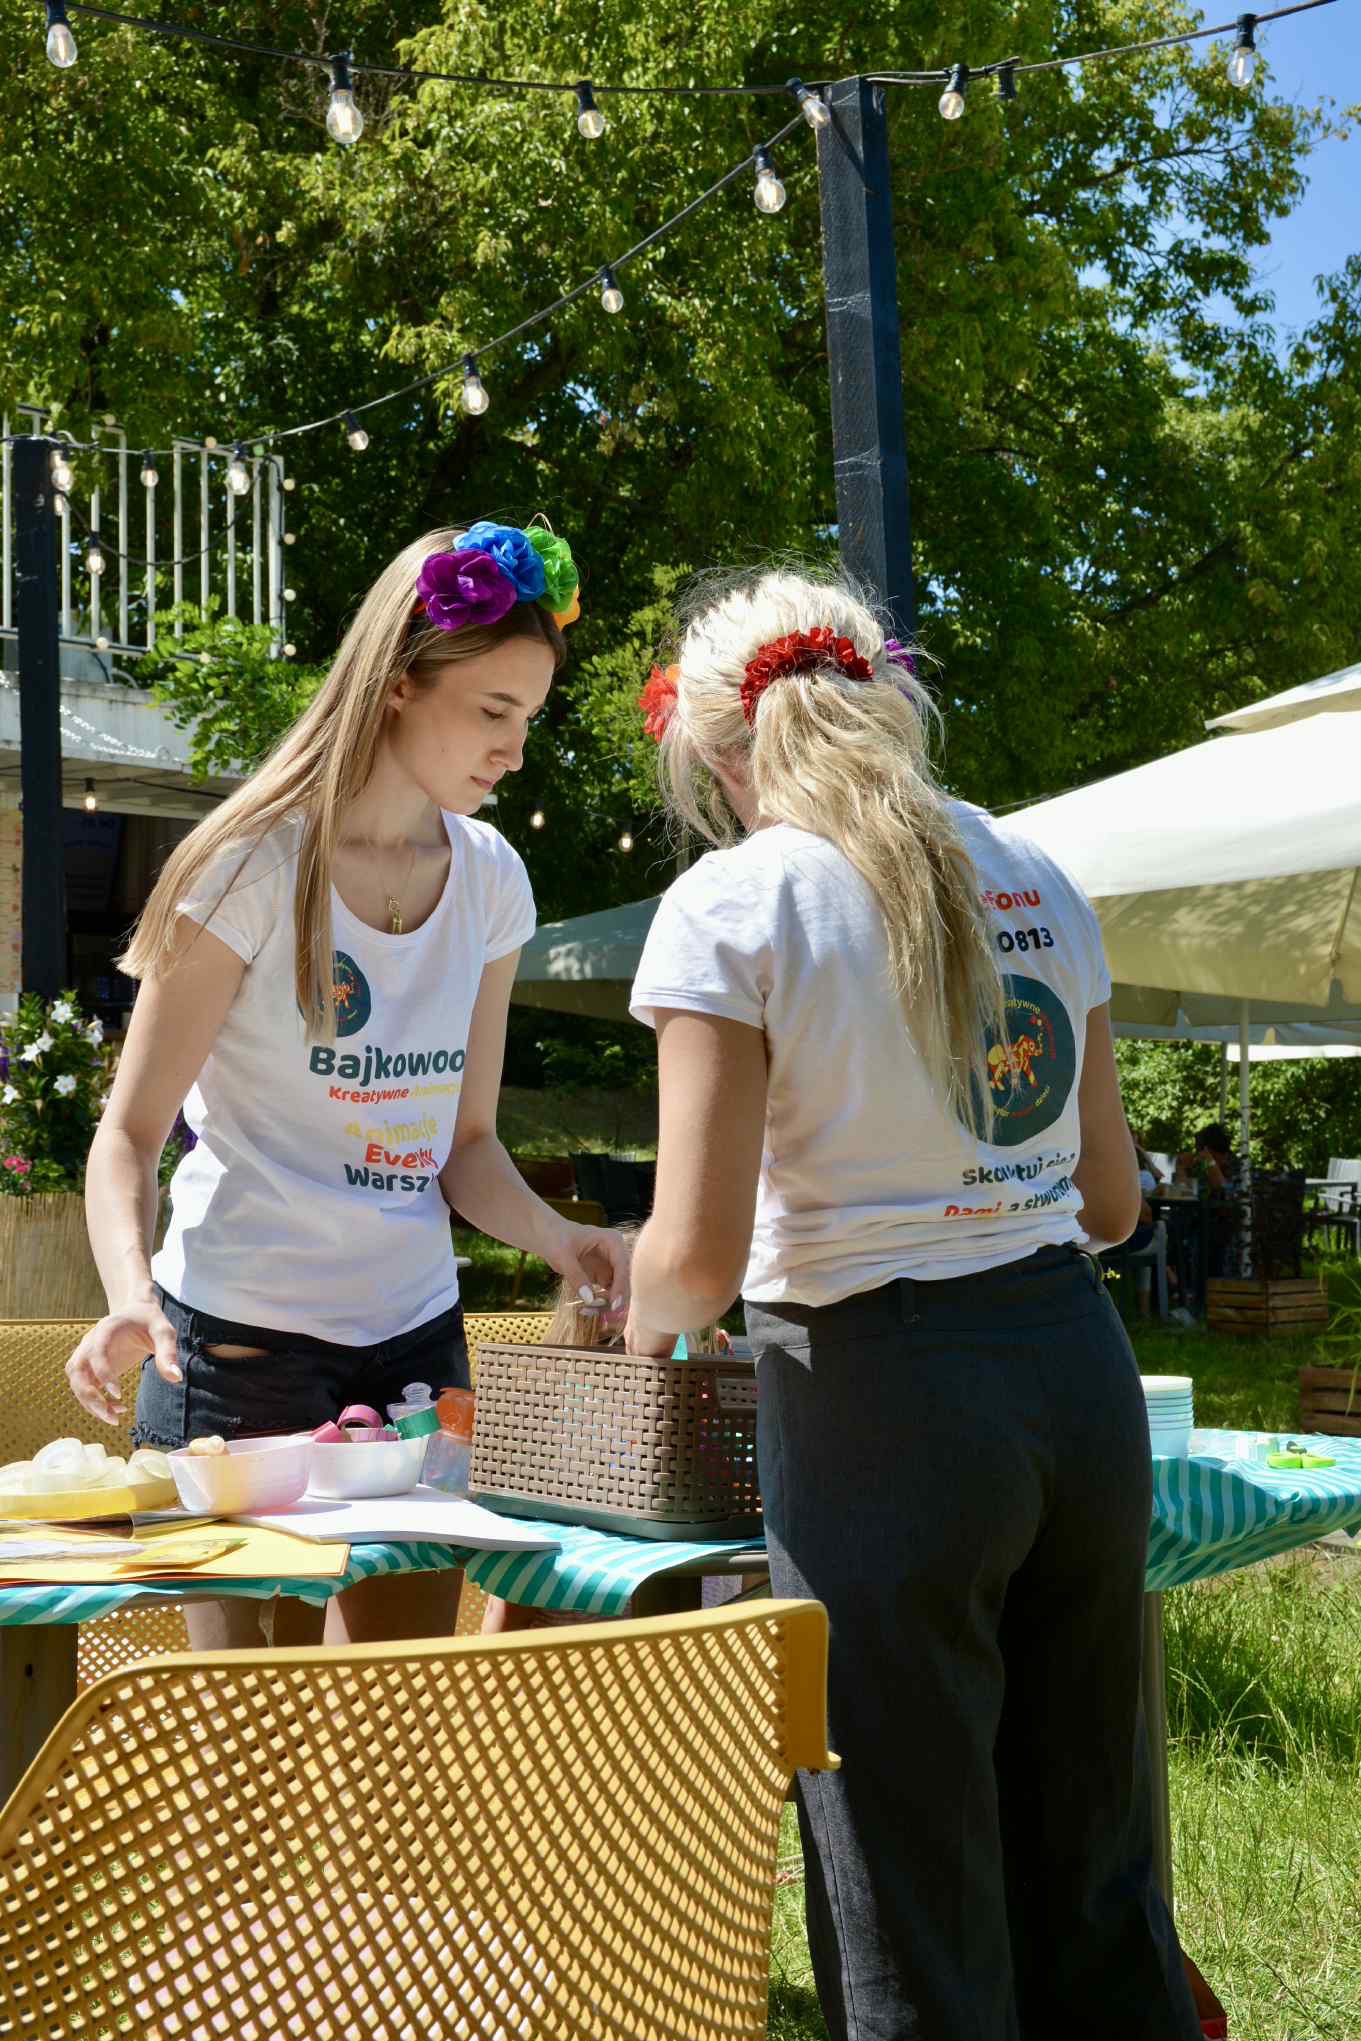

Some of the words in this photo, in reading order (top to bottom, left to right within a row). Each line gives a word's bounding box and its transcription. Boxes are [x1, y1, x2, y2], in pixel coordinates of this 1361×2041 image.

[997, 927, 1055, 953] 0813
[309, 1045, 466, 1087] Bajkowoo
[328, 1085, 410, 1104] Kreatywne
